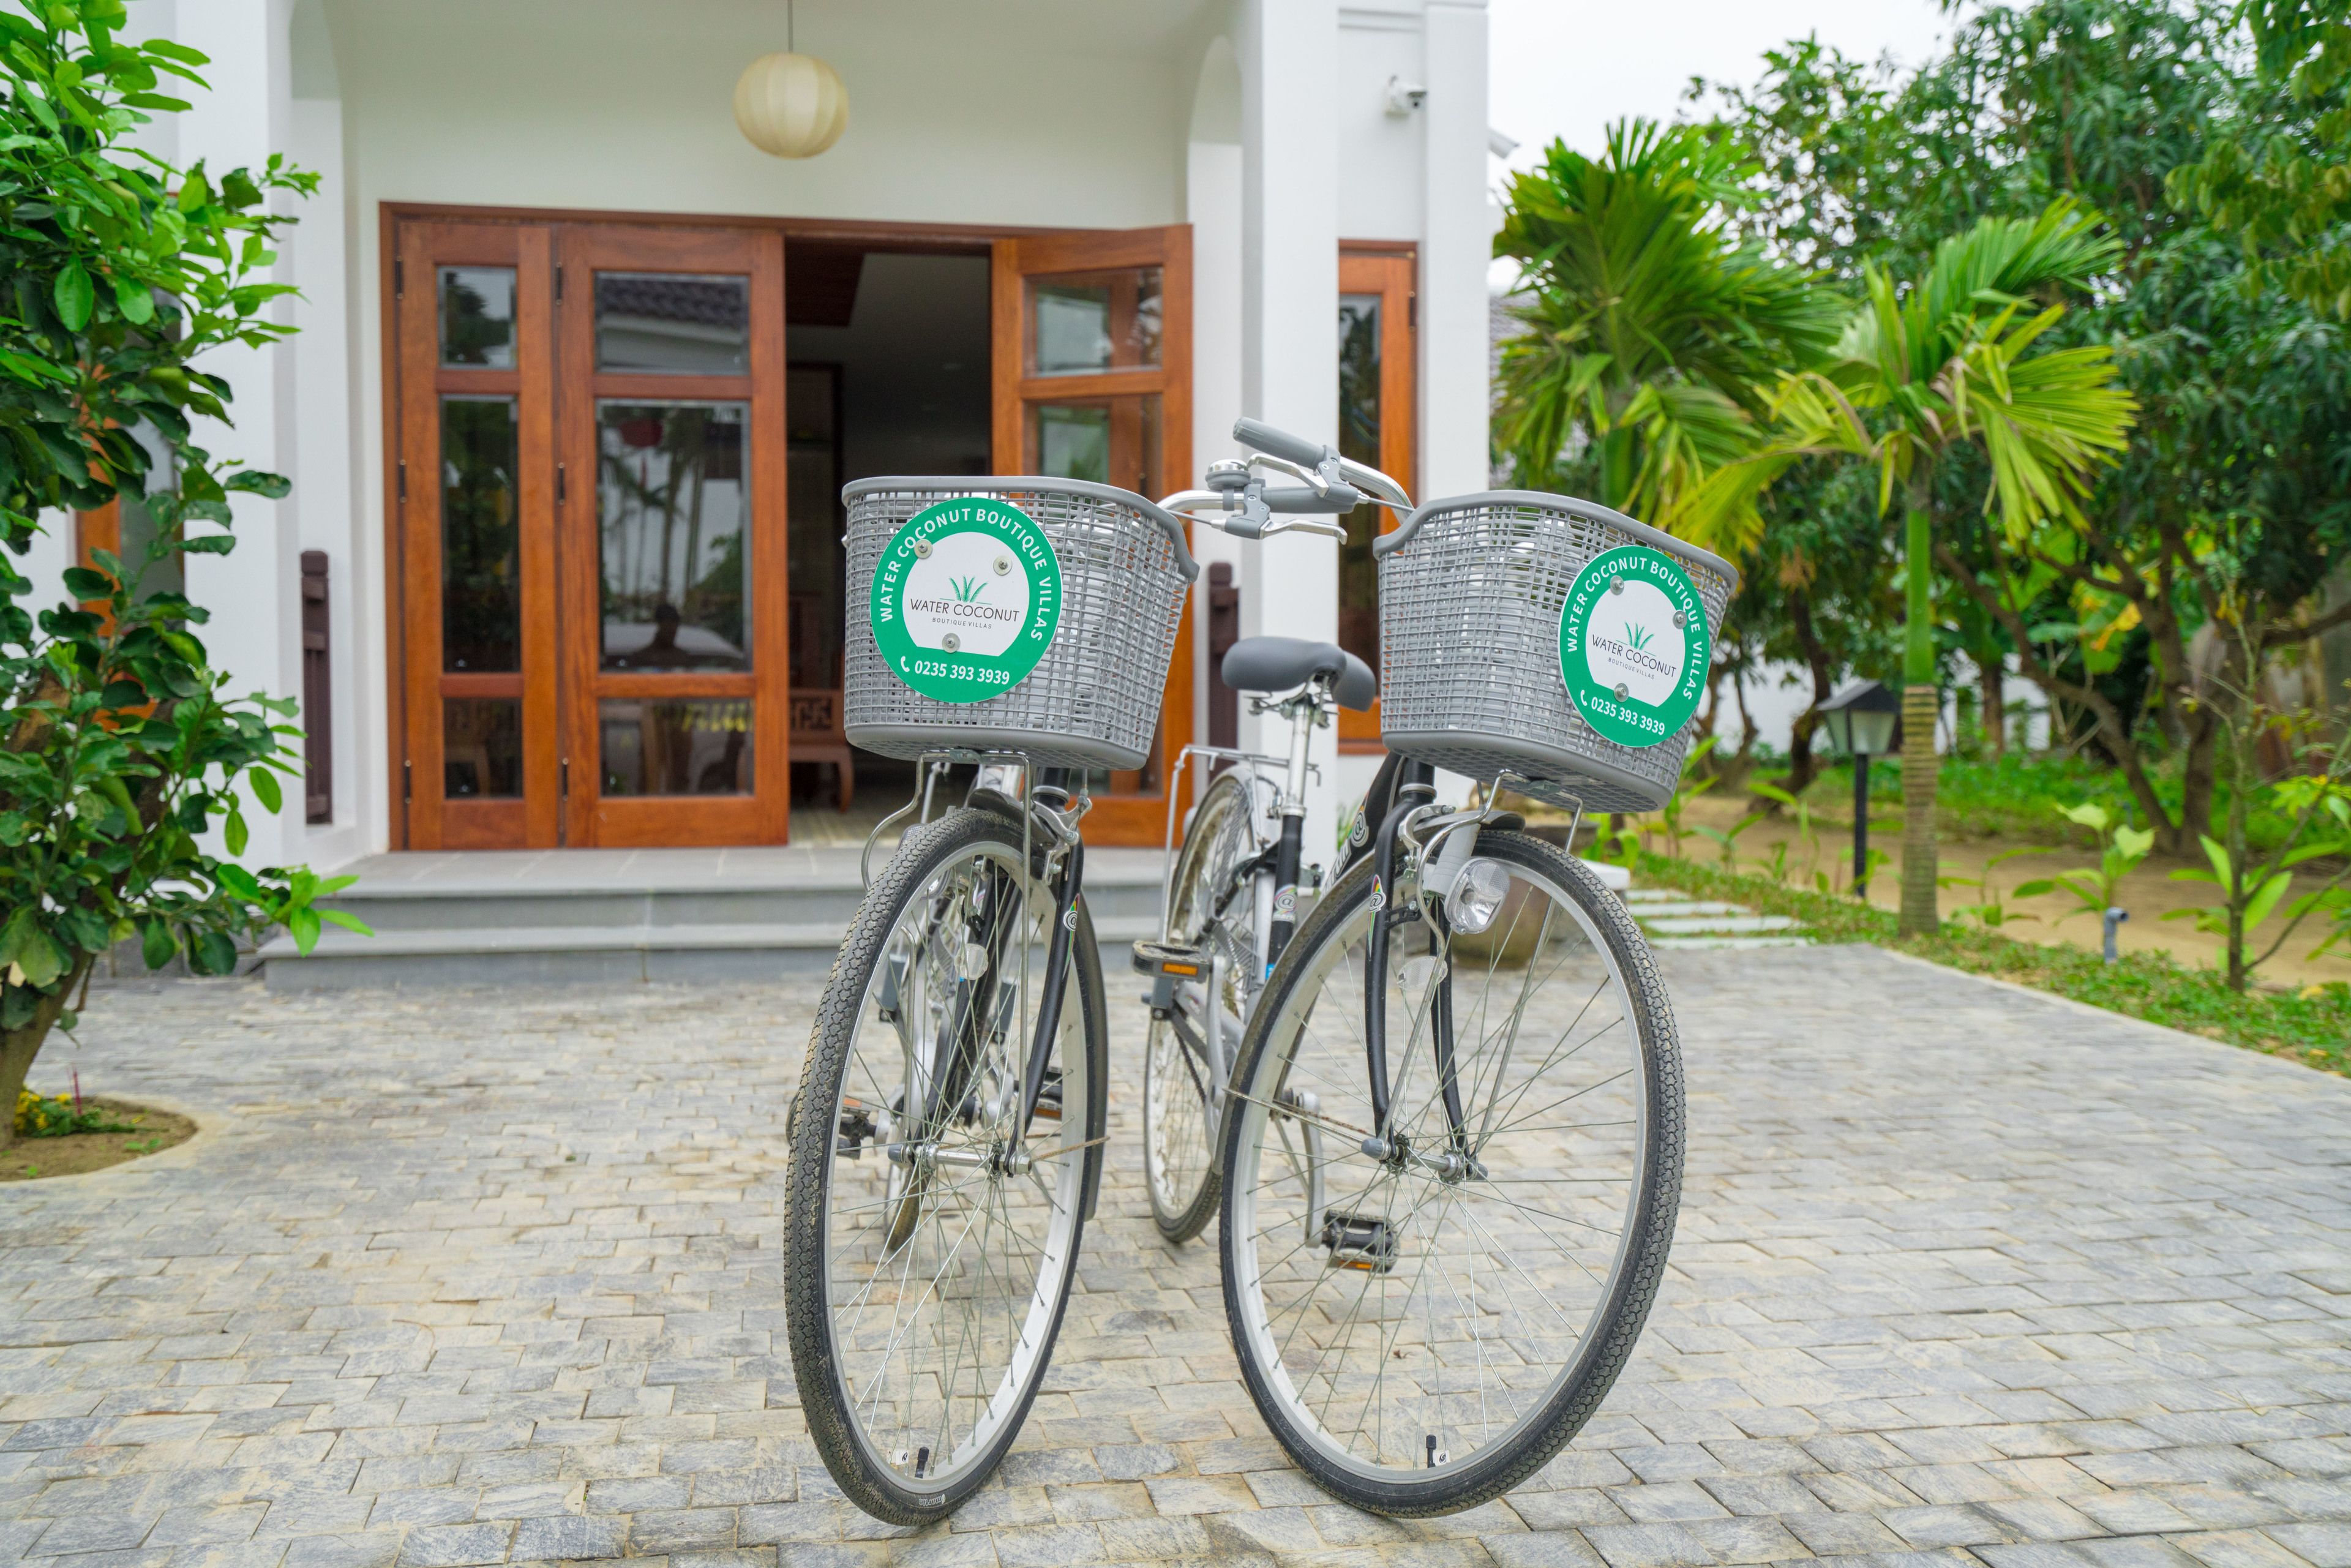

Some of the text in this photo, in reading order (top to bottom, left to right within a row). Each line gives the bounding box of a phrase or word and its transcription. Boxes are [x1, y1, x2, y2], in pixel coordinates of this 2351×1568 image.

[880, 508, 1052, 641] WATER COCONUT BOUTIQUE VILLAS
[910, 598, 1020, 622] WATER COCONUT
[932, 617, 992, 629] BOUTIQUE VILLAS
[1567, 557, 1702, 700] WATER COCONUT BOUTIQUE VILLAS
[1592, 634, 1677, 678] WATER COCONUT
[1608, 657, 1655, 680] BOUTIQUE VILLAS
[915, 660, 1010, 685] 0235 393 3939
[1591, 696, 1665, 735] 0235 393 3939
